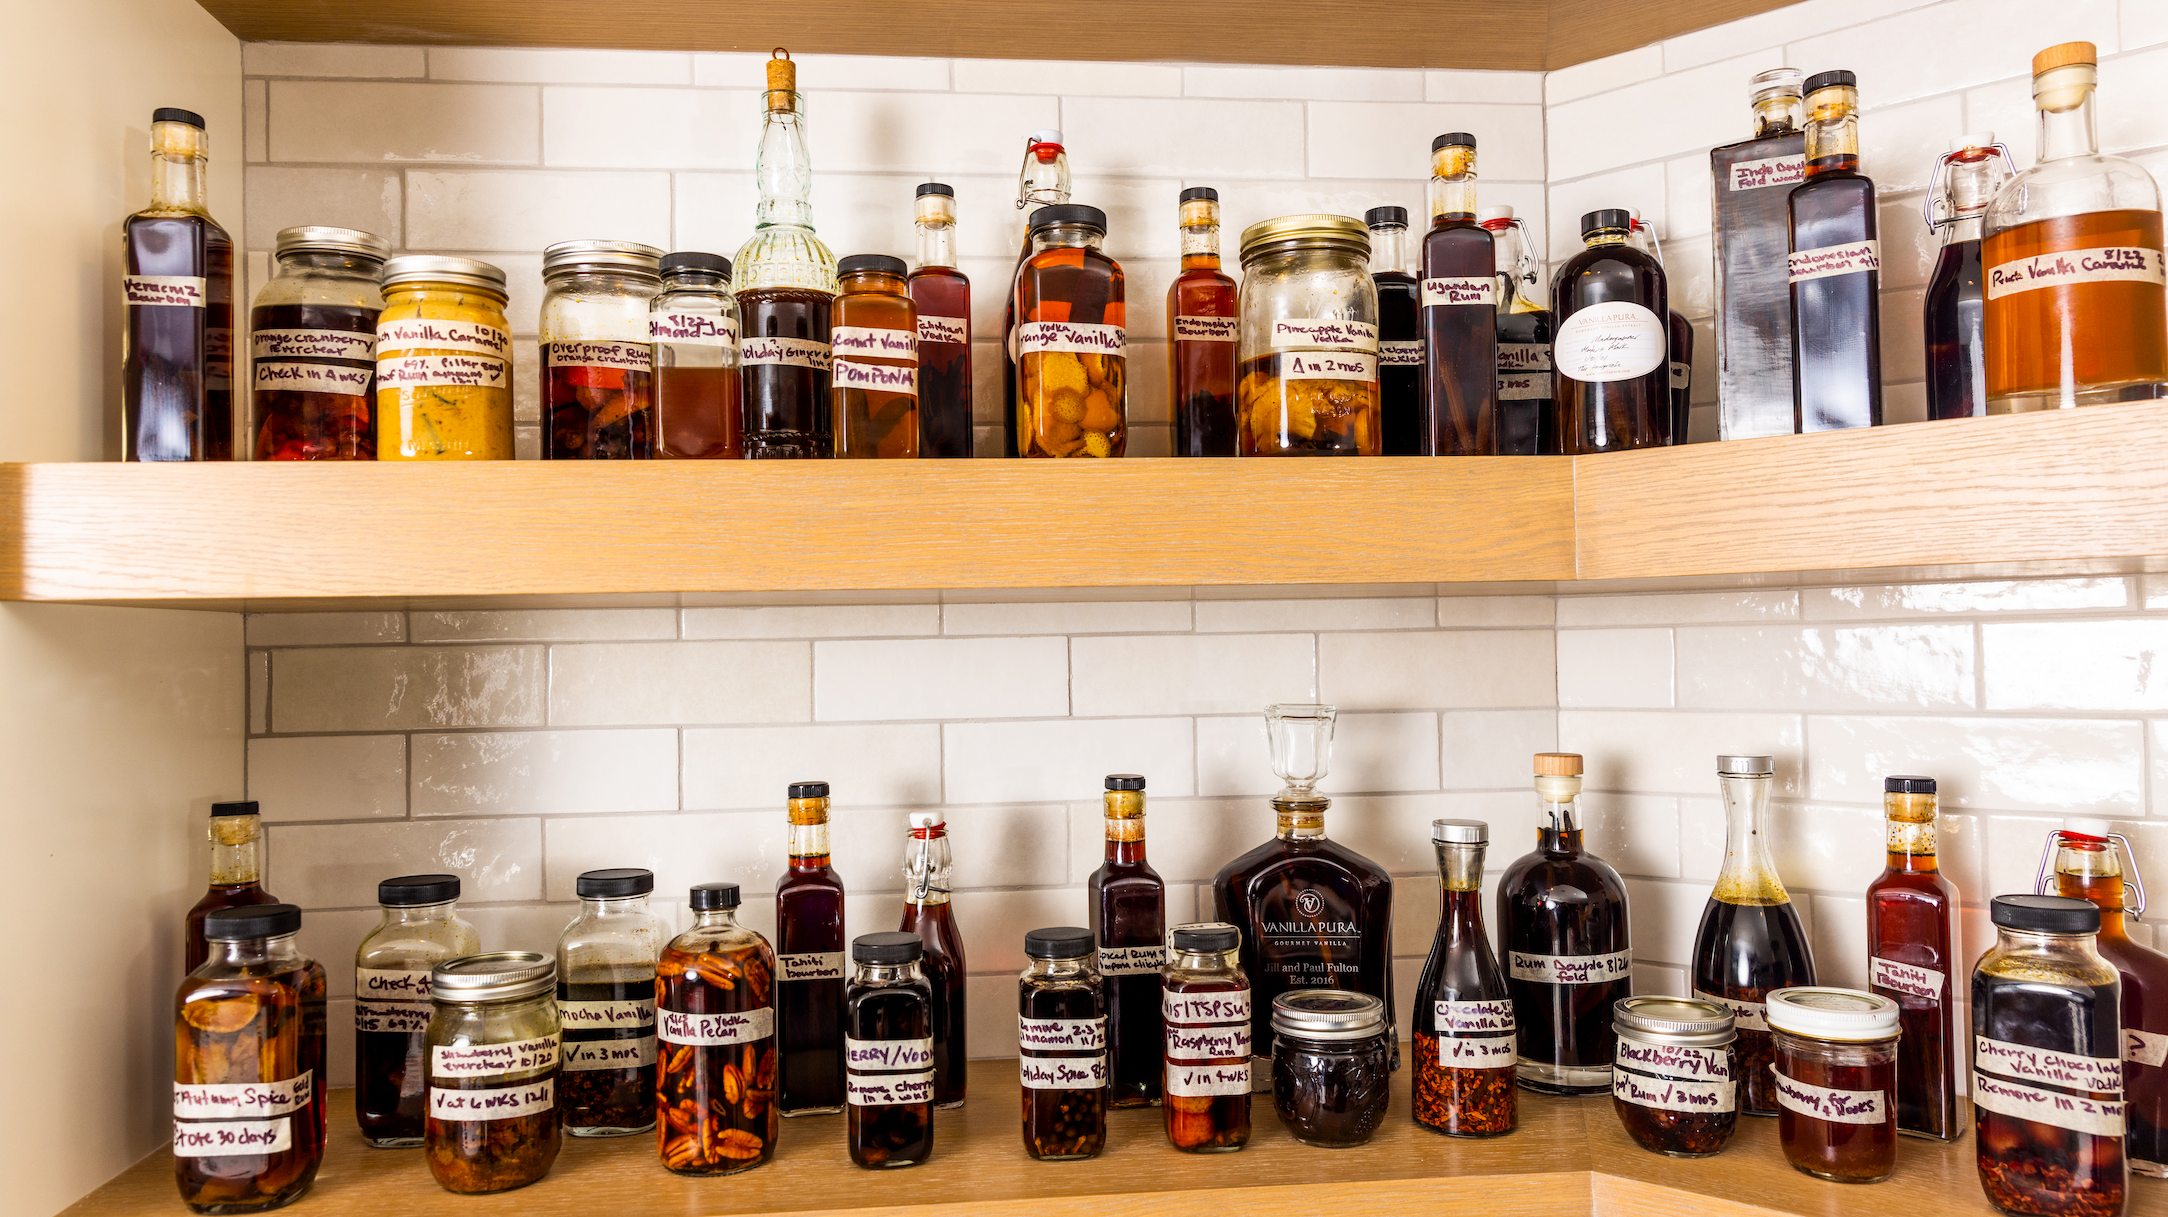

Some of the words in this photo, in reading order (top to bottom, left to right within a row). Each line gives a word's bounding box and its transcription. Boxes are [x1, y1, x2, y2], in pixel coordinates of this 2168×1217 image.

[1427, 281, 1490, 295] Ugandan
[1450, 290, 1481, 303] Rum
[394, 324, 447, 341] Vanilla
[449, 329, 503, 352] Caramel
[702, 321, 736, 344] Joy
[1020, 331, 1057, 346] range
[1065, 330, 1120, 348] Vanilla
[1498, 348, 1539, 363] anilla
[260, 366, 303, 380] Check
[307, 370, 321, 380] in
[1265, 962, 1280, 973] Jill
[1282, 962, 1301, 973] and
[1302, 962, 1325, 973] Paul
[1327, 962, 1359, 973] Fulton
[1515, 955, 1545, 969] Rum
[369, 974, 416, 990] Check
[1289, 975, 1308, 985] Est.
[1310, 975, 1335, 985] 2016
[605, 1002, 652, 1023] Vanilla
[700, 1019, 737, 1038] Pecan
[1445, 1015, 1498, 1029] Vanilla
[518, 1038, 557, 1053] Vanilla
[600, 1048, 608, 1060] 3
[1979, 1041, 2036, 1066] Cherry
[2010, 1060, 2078, 1081] Vanilla
[244, 1088, 291, 1108] Spice
[1631, 1084, 1657, 1102] Rum
[1676, 1090, 1687, 1103] 3
[2080, 1101, 2097, 1114] 2
[217, 1130, 235, 1146] 30
[238, 1127, 277, 1145] days
